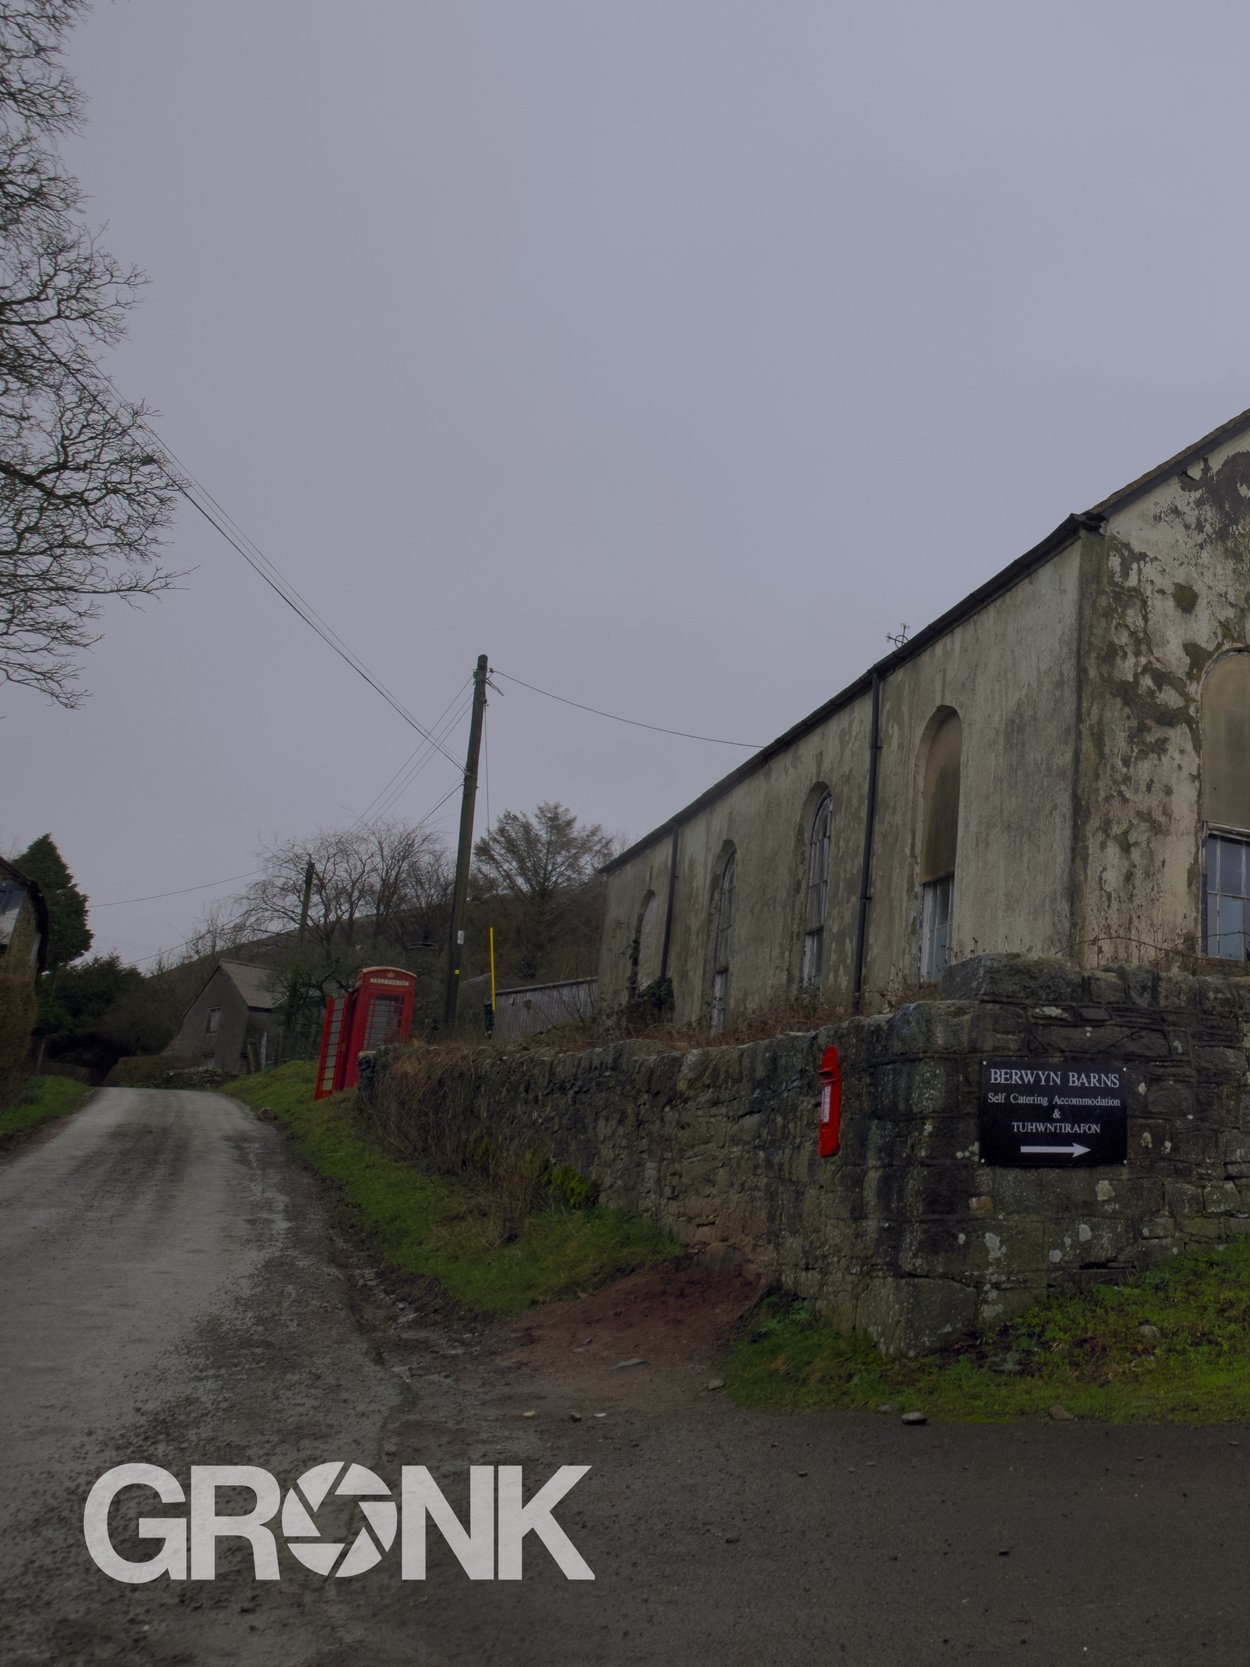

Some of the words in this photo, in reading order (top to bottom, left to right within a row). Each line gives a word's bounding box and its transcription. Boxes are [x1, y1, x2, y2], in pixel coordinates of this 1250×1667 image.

[990, 1069, 1061, 1085] BERWYN
[1068, 1072, 1119, 1087] BARNS
[988, 1093, 1006, 1103] Self
[1010, 1093, 1048, 1106] Catering
[1053, 1095, 1120, 1106] Accommodation
[1053, 1109, 1061, 1118] &
